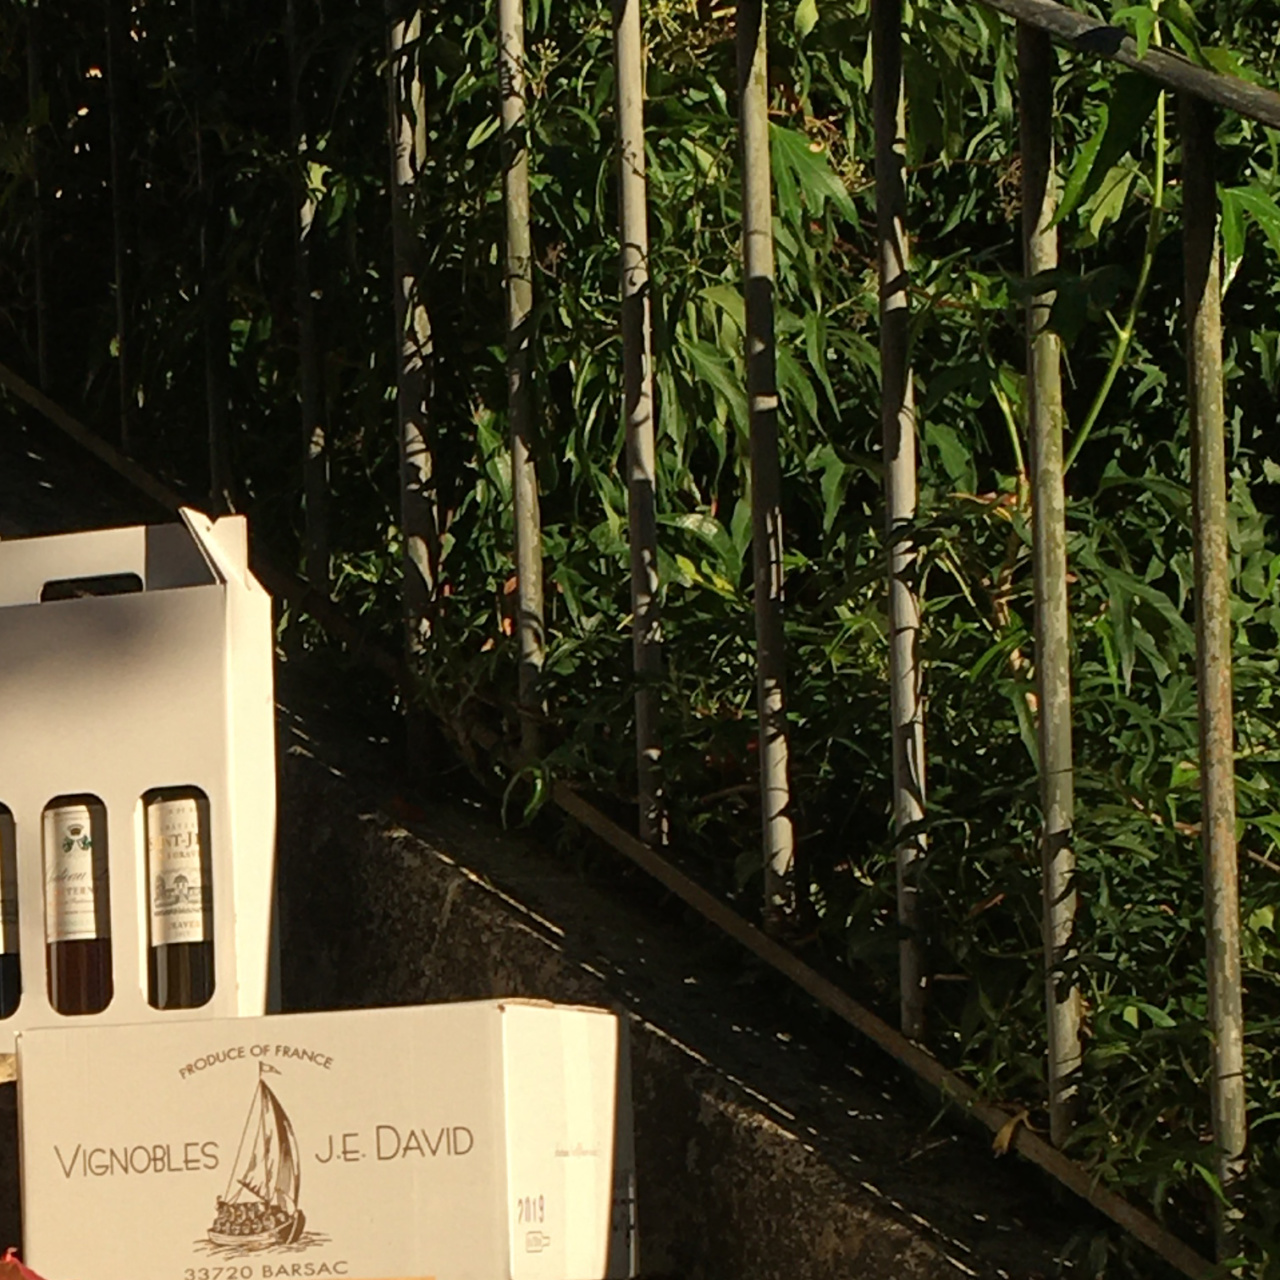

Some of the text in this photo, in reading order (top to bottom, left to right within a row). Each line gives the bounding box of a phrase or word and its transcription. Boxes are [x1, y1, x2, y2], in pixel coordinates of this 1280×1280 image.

[178, 1043, 335, 1080] PRODUCE OF FRANCE
[262, 1259, 349, 1279] BARSAC
